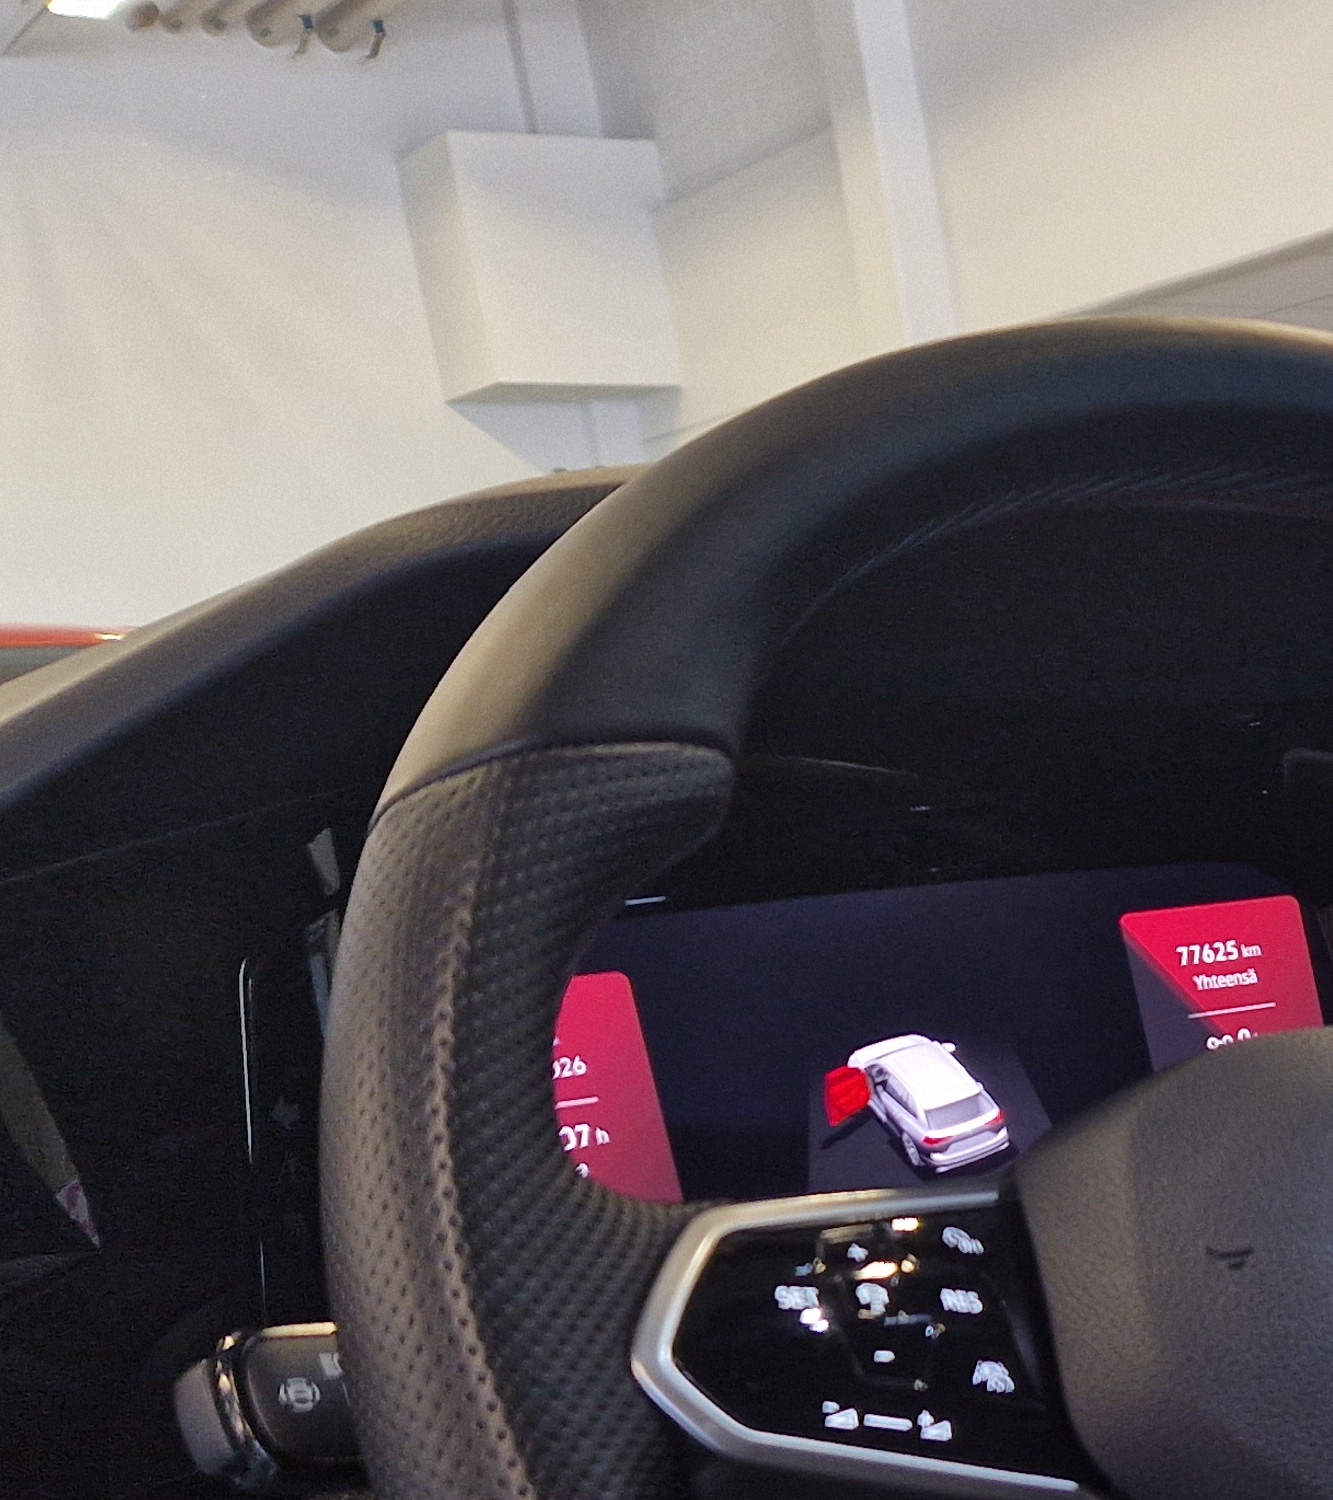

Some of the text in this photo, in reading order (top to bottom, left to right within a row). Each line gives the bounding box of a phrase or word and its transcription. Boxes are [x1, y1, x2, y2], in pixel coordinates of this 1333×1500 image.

[1176, 940, 1262, 966] 77625 km
[1193, 968, 1258, 990] Yhteensä
[775, 1285, 820, 1310] SET
[940, 1288, 983, 1314] RES
